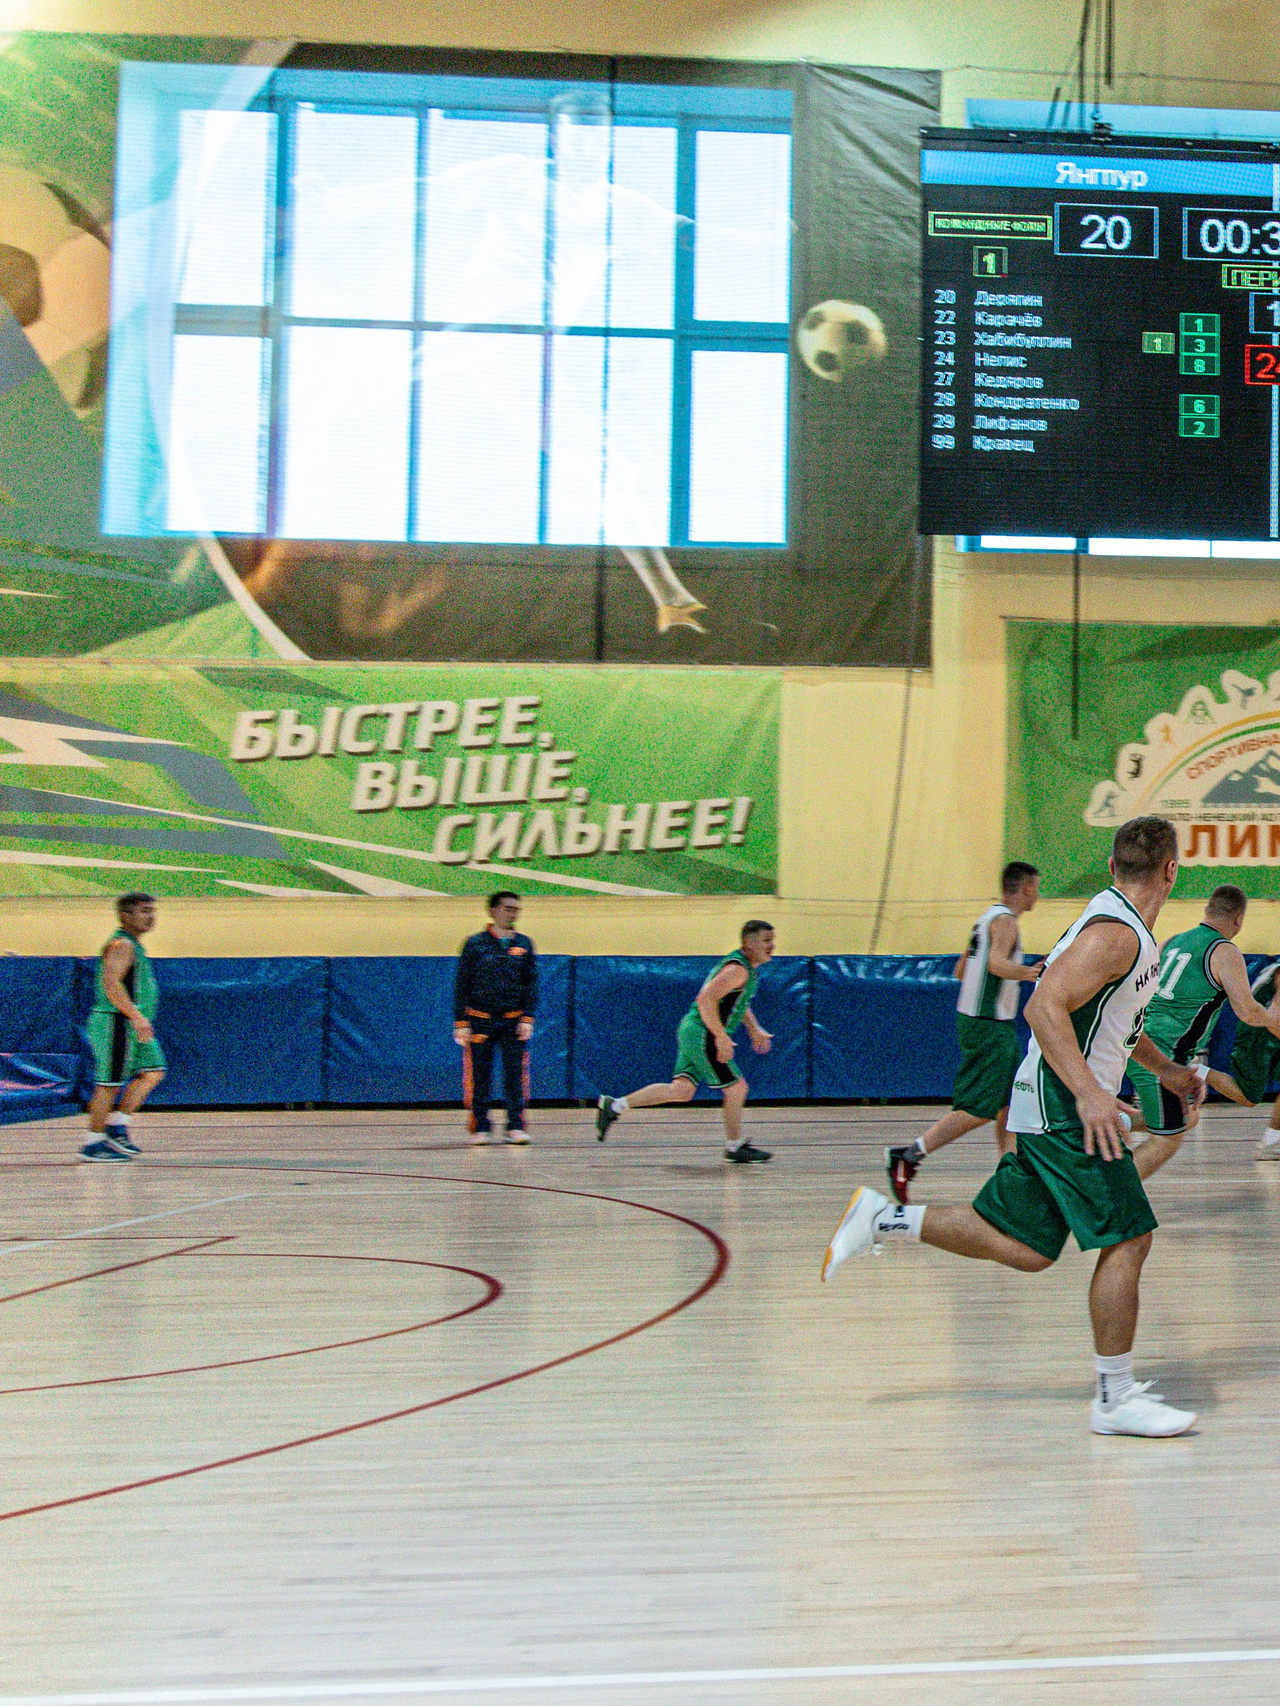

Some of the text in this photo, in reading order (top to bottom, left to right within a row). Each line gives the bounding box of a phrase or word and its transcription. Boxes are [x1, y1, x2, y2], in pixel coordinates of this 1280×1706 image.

[1080, 214, 1132, 250] 20
[982, 252, 996, 274] 1
[934, 289, 957, 304] 20
[934, 309, 1043, 327] 22 Карачёв
[1266, 300, 1280, 327] 1
[1194, 318, 1204, 332] 1
[934, 330, 956, 345] 23
[1152, 337, 1162, 351] 1
[1194, 338, 1206, 353] 3
[934, 351, 956, 366] 24
[933, 371, 956, 386] 27
[1193, 399, 1206, 413] 6
[1193, 421, 1206, 435] 2
[229, 695, 555, 762] БЫСТРЕЕ,
[351, 750, 590, 814] ВЫШЕ,
[433, 796, 752, 866] СИЛЬНЕЕ!
[1155, 947, 1192, 1000] 11
